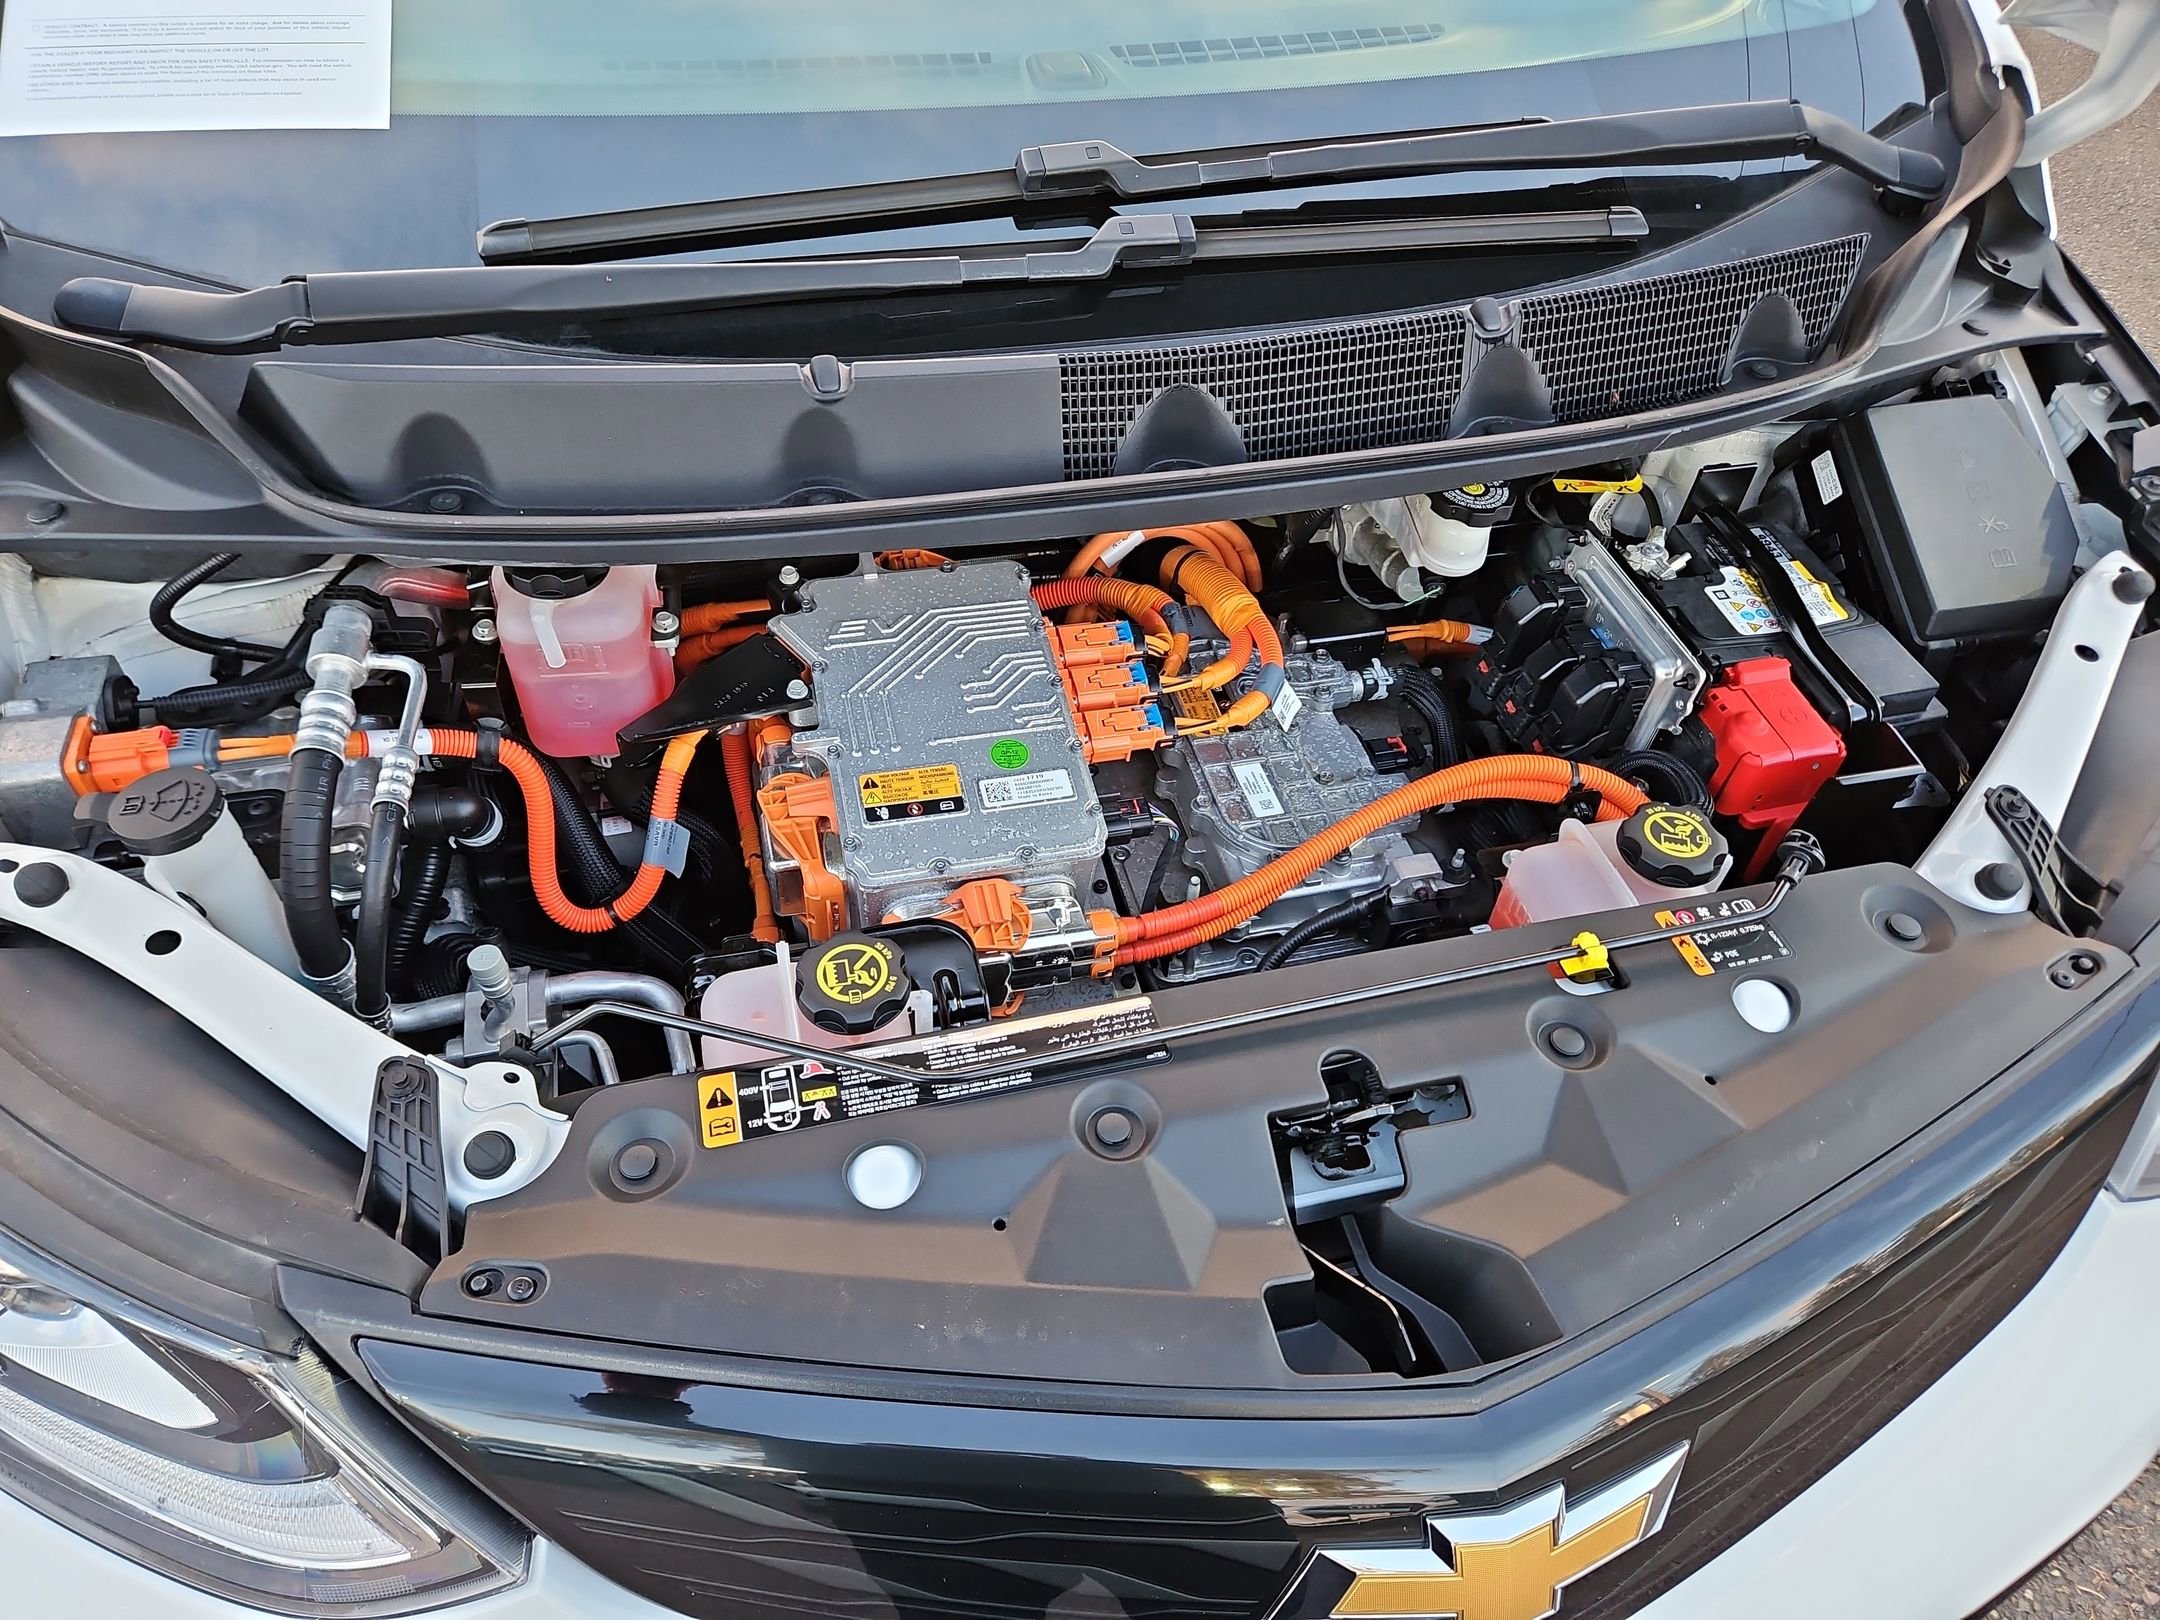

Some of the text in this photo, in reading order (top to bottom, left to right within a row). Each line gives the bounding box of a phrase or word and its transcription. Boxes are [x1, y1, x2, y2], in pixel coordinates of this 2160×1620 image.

[874, 942, 894, 960] 35 kPa
[1724, 949, 1740, 959] POE
[884, 982, 897, 993] PSI
[738, 1085, 759, 1097] 400V
[746, 1117, 763, 1128] 12V
